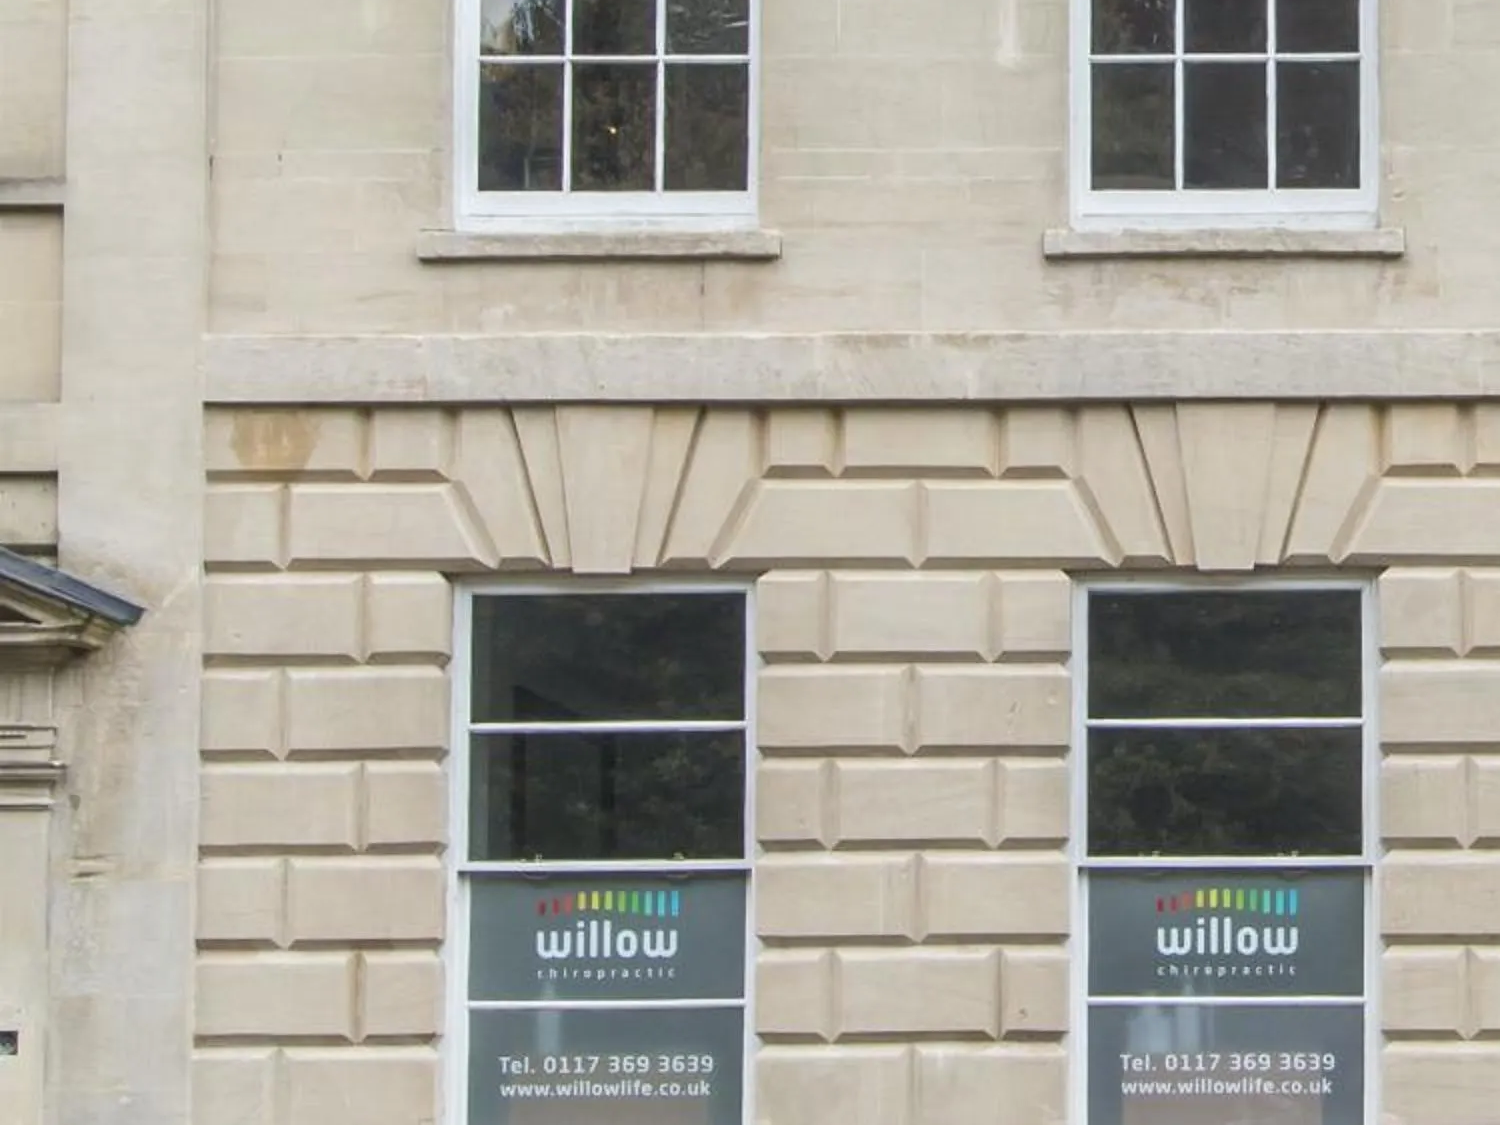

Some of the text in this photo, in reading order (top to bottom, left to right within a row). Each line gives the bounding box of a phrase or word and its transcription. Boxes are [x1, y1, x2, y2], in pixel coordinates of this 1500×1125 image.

[535, 920, 678, 958] willow
[1157, 916, 1298, 955] willow
[537, 966, 676, 980] chiropractic
[1157, 963, 1297, 978] chiropractic
[499, 1055, 714, 1074] Tel. 0117 369 3639
[1120, 1053, 1336, 1072] Tel. 0117 369 3639
[500, 1079, 711, 1097] www.willowlife.co.uk
[1121, 1077, 1333, 1095] www.willowlife.co.uk
